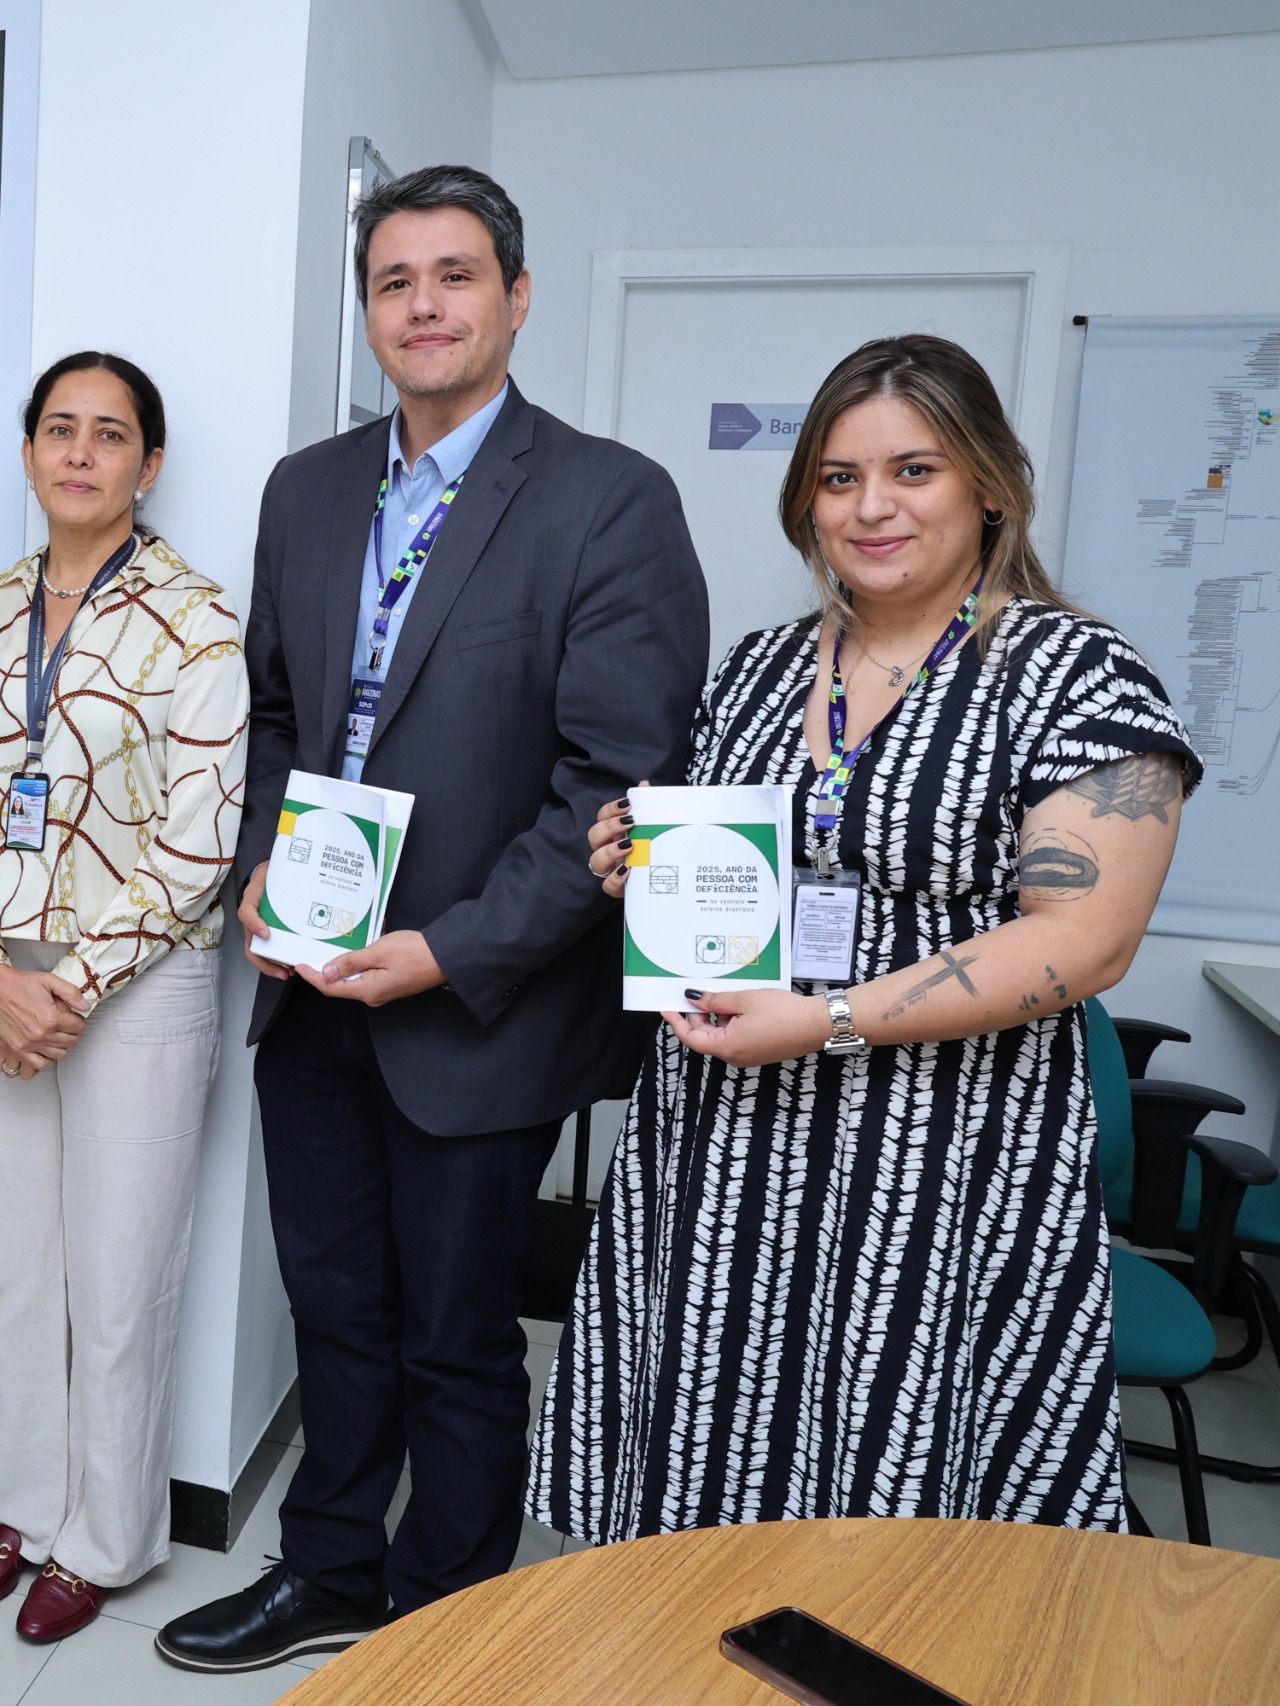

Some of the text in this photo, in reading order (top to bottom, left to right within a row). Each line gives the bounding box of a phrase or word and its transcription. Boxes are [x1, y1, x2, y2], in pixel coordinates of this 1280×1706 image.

[324, 845, 342, 855] 2025,
[344, 850, 356, 858] ANO
[322, 852, 364, 869] PESSOA COM
[697, 866, 722, 874] 2025,
[696, 875, 758, 883] PESSOA COM
